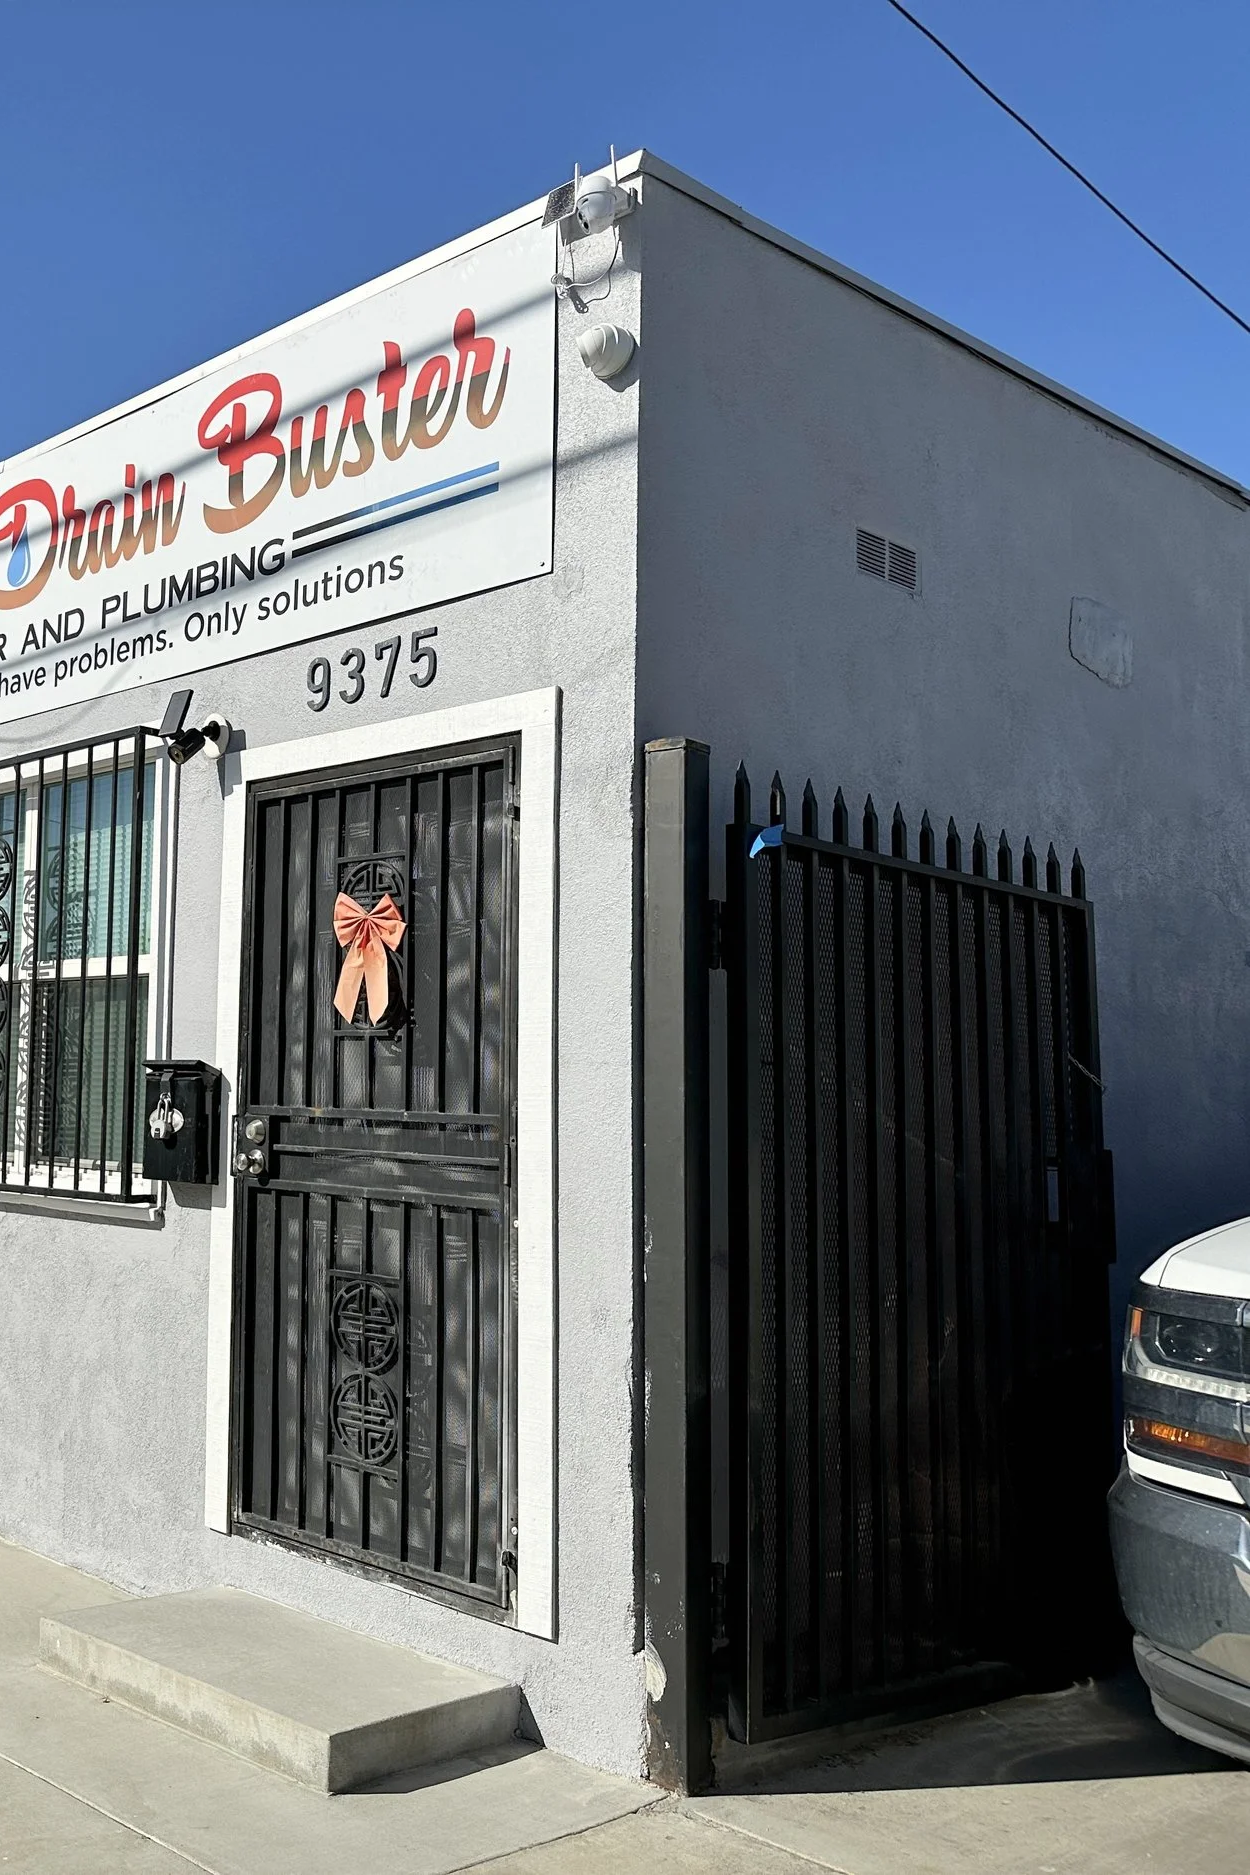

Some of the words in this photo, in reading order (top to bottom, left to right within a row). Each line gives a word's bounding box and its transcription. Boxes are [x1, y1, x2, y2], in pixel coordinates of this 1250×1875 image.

[197, 308, 511, 535] Buster
[20, 607, 85, 655] AND
[100, 538, 286, 629] PLUMBING
[53, 628, 175, 688] problems.
[183, 601, 248, 642] Only
[257, 554, 405, 621] solutions
[306, 626, 439, 713] 9375
